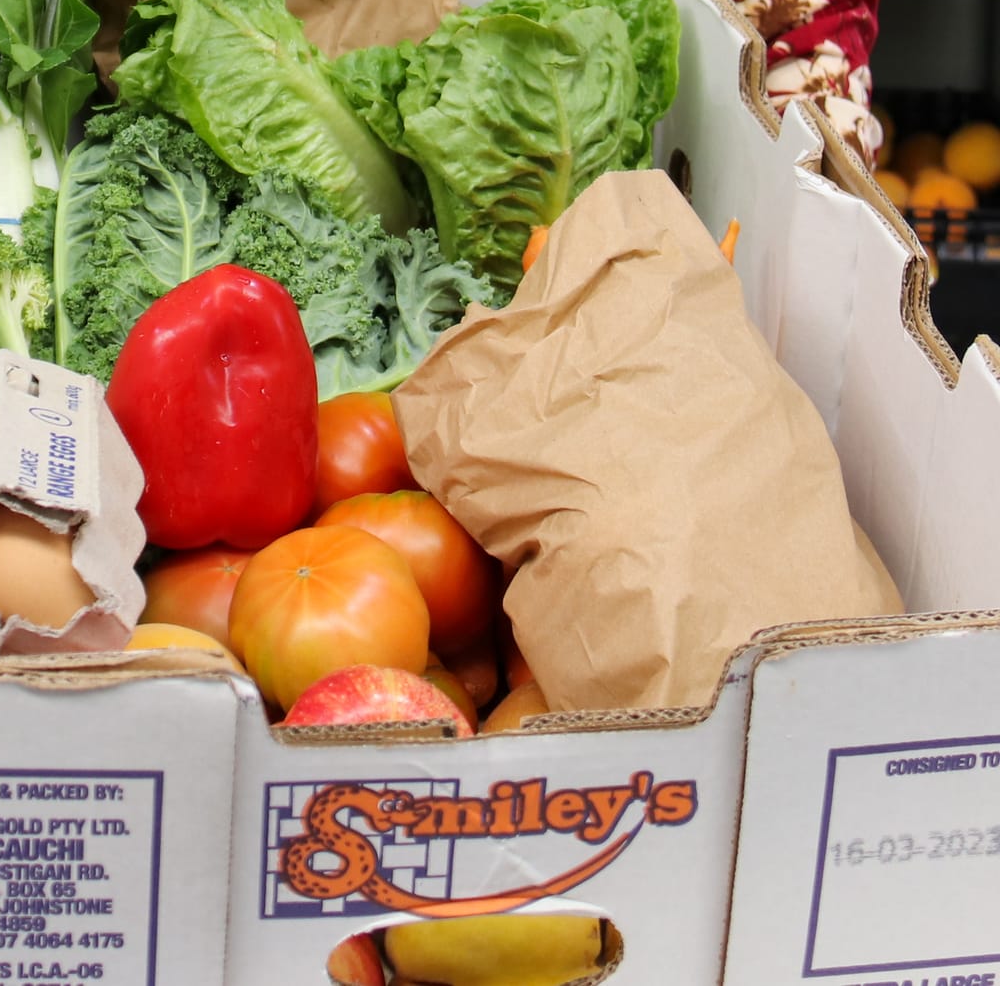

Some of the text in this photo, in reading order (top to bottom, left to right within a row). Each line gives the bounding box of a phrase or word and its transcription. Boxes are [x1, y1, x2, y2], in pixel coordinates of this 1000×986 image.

[18, 448, 39, 490] 12 LARGE
[46, 432, 77, 500] RANGE EGGS
[885, 752, 977, 776] CONSIGNED
[16, 782, 89, 801] PACKED
[93, 784, 124, 801] BY:
[48, 818, 86, 835] PTY
[90, 818, 130, 836] LTD.
[831, 825, 1000, 866] 16-03-2023
[77, 864, 110, 881] RD.
[6, 881, 47, 898] BOX
[51, 882, 77, 898] 65
[23, 932, 73, 949] 4064
[77, 932, 125, 949] 4175
